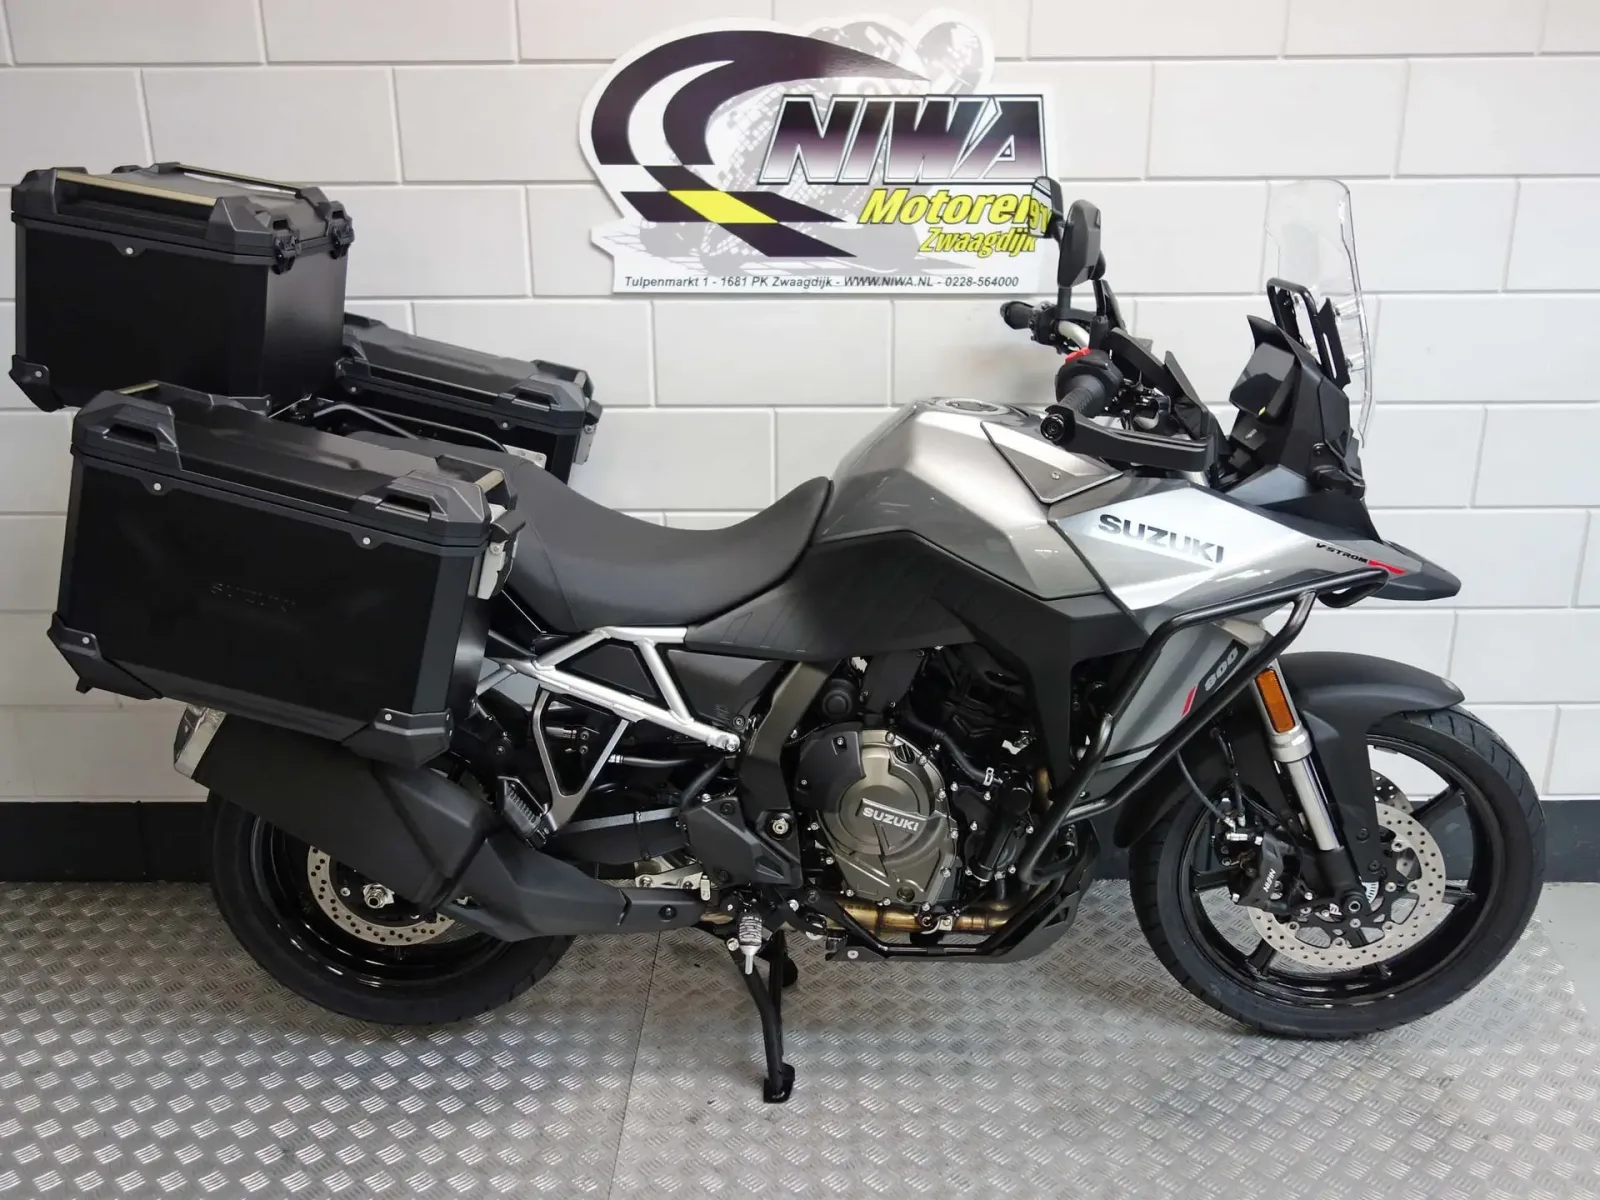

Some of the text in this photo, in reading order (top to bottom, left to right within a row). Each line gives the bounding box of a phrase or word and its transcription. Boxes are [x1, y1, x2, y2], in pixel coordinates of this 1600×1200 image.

[757, 94, 1048, 185] NIWA
[624, 276, 699, 288] Tulpenmarkt
[702, 276, 709, 287] 1
[720, 276, 748, 287] 1681
[751, 276, 769, 287] PK
[772, 276, 833, 289] Zwaagdijk
[844, 276, 934, 287] WWW.NIWA.NL
[944, 276, 1020, 287] 0228-564000
[1098, 513, 1224, 563] SUZUKI
[1204, 646, 1239, 692] 800
[862, 806, 920, 832] SUZUKI
